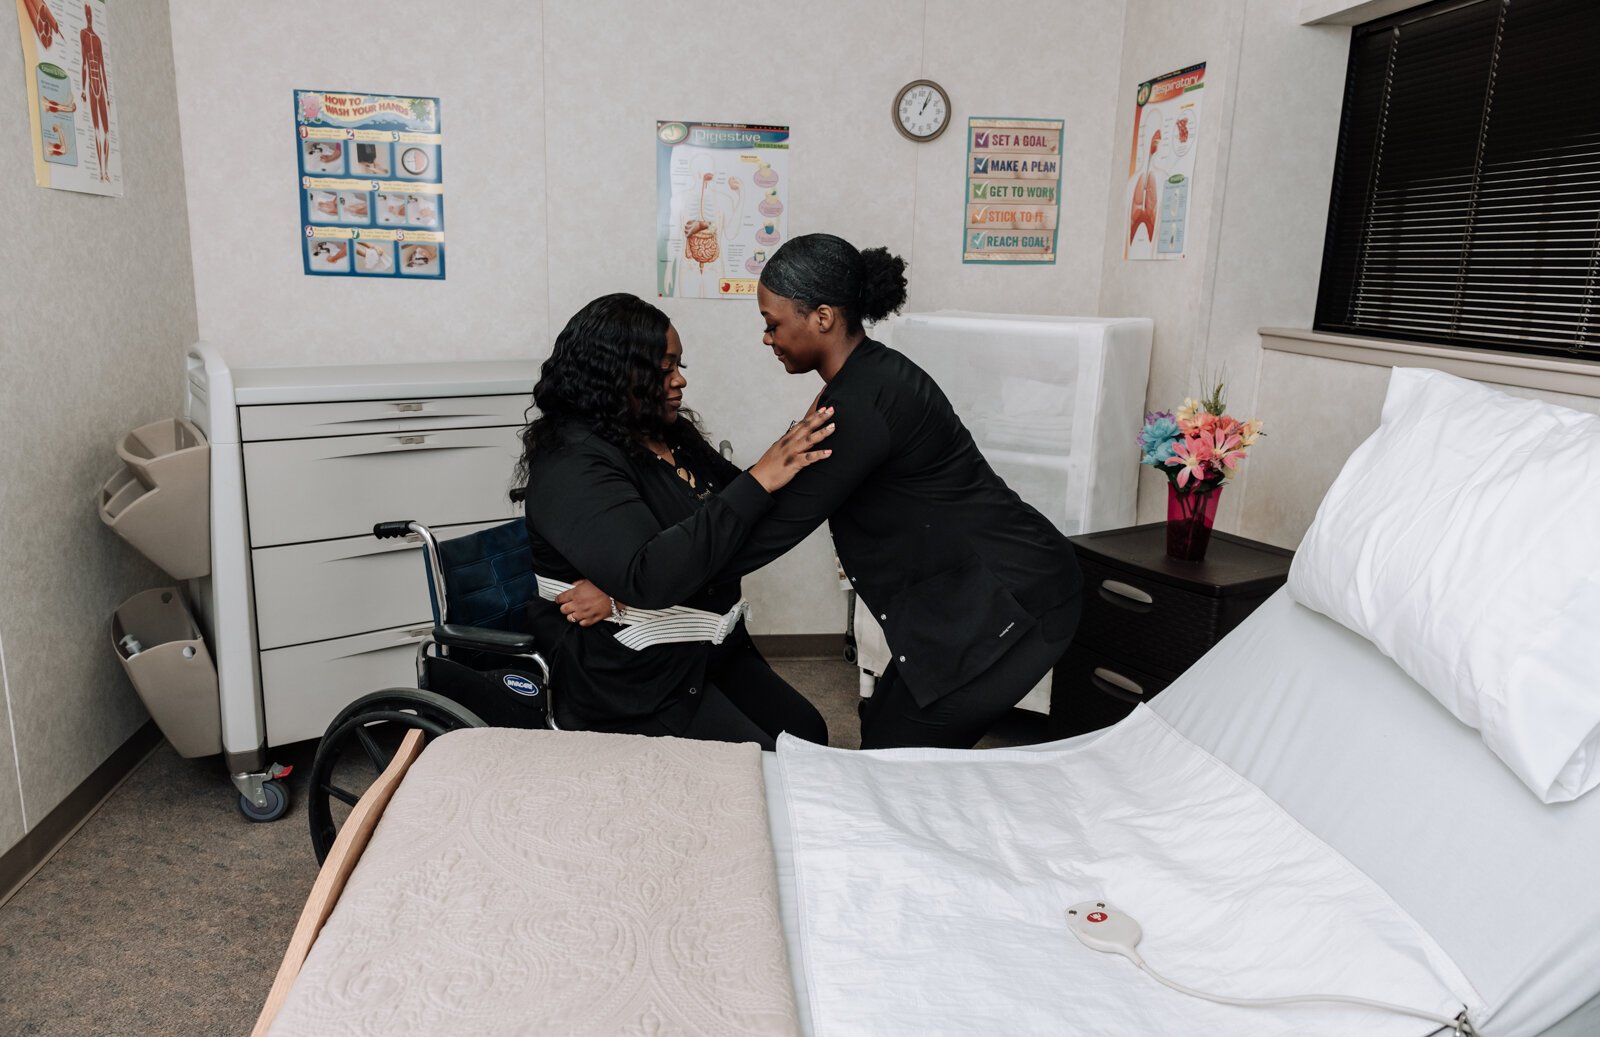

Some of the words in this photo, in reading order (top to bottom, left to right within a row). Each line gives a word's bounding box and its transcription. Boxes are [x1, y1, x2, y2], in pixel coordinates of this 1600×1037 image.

[324, 95, 346, 106] HOW
[349, 97, 362, 106] TO
[325, 105, 350, 116] WASH
[352, 103, 377, 116] YOUR
[378, 101, 409, 116] HANDS
[300, 126, 309, 138] 1
[346, 128, 355, 140] 2
[392, 131, 400, 141] 3
[695, 129, 761, 143] Digestive
[992, 134, 1010, 146] SET
[1013, 135, 1020, 146] A
[1023, 135, 1047, 147] GOAL
[991, 160, 1019, 172] MAKE
[1021, 160, 1028, 172] A
[1031, 161, 1056, 172] PLAN
[371, 180, 380, 191] 5
[990, 186, 1008, 197] GET
[1011, 187, 1024, 198] TO
[1027, 187, 1055, 198] WORK
[988, 211, 1017, 222] STICK
[1020, 211, 1032, 222] TO
[1035, 212, 1044, 223] IT
[305, 226, 314, 238] 6
[351, 227, 360, 239] 7
[396, 229, 404, 241] 8
[987, 236, 1018, 247] REACH
